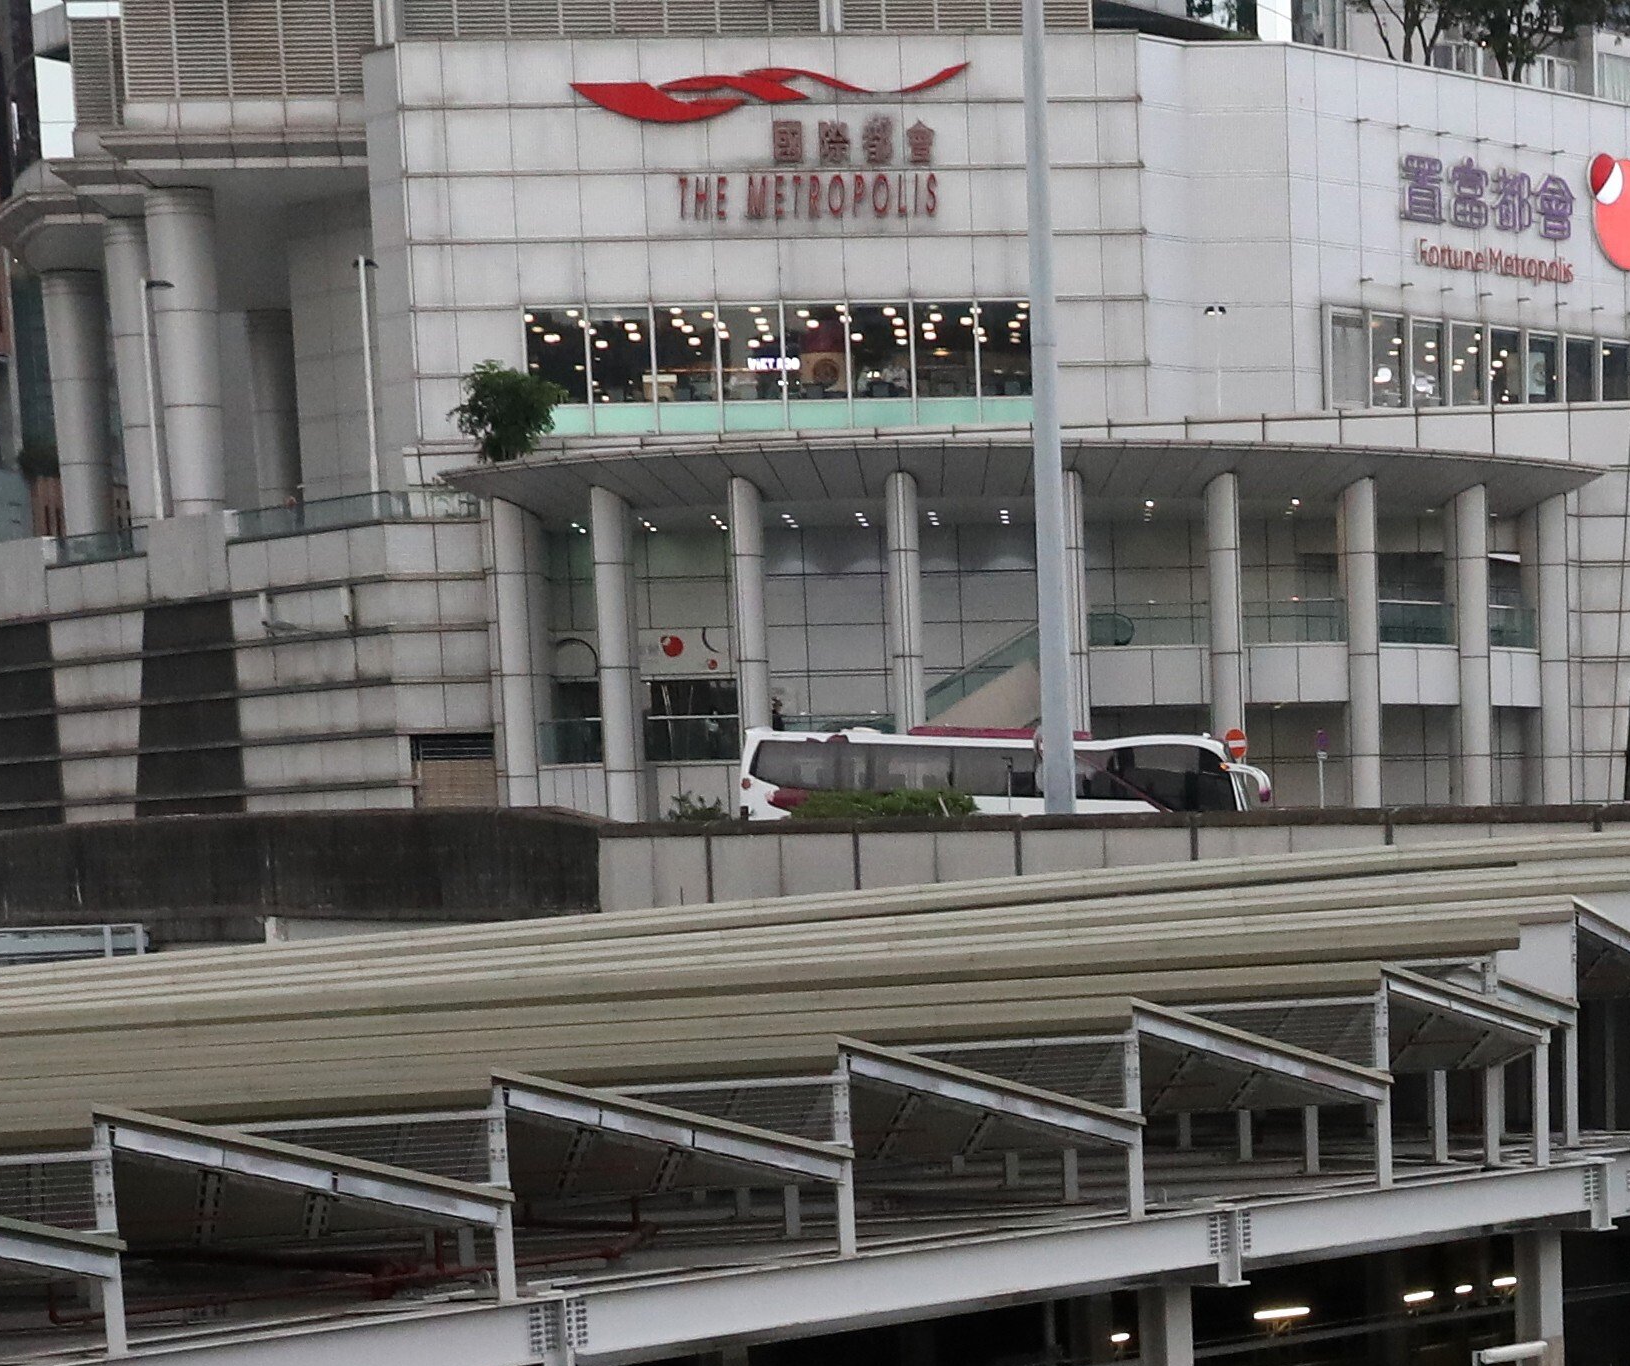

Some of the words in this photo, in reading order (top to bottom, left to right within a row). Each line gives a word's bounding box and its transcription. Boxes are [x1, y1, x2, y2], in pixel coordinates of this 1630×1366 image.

[772, 115, 935, 164] 國際都會
[678, 175, 727, 220] THE
[746, 172, 937, 220] METROPOLIS
[1400, 154, 1576, 240] 置富都會
[1415, 237, 1487, 272] Fortune
[1488, 246, 1574, 286] Metropolis
